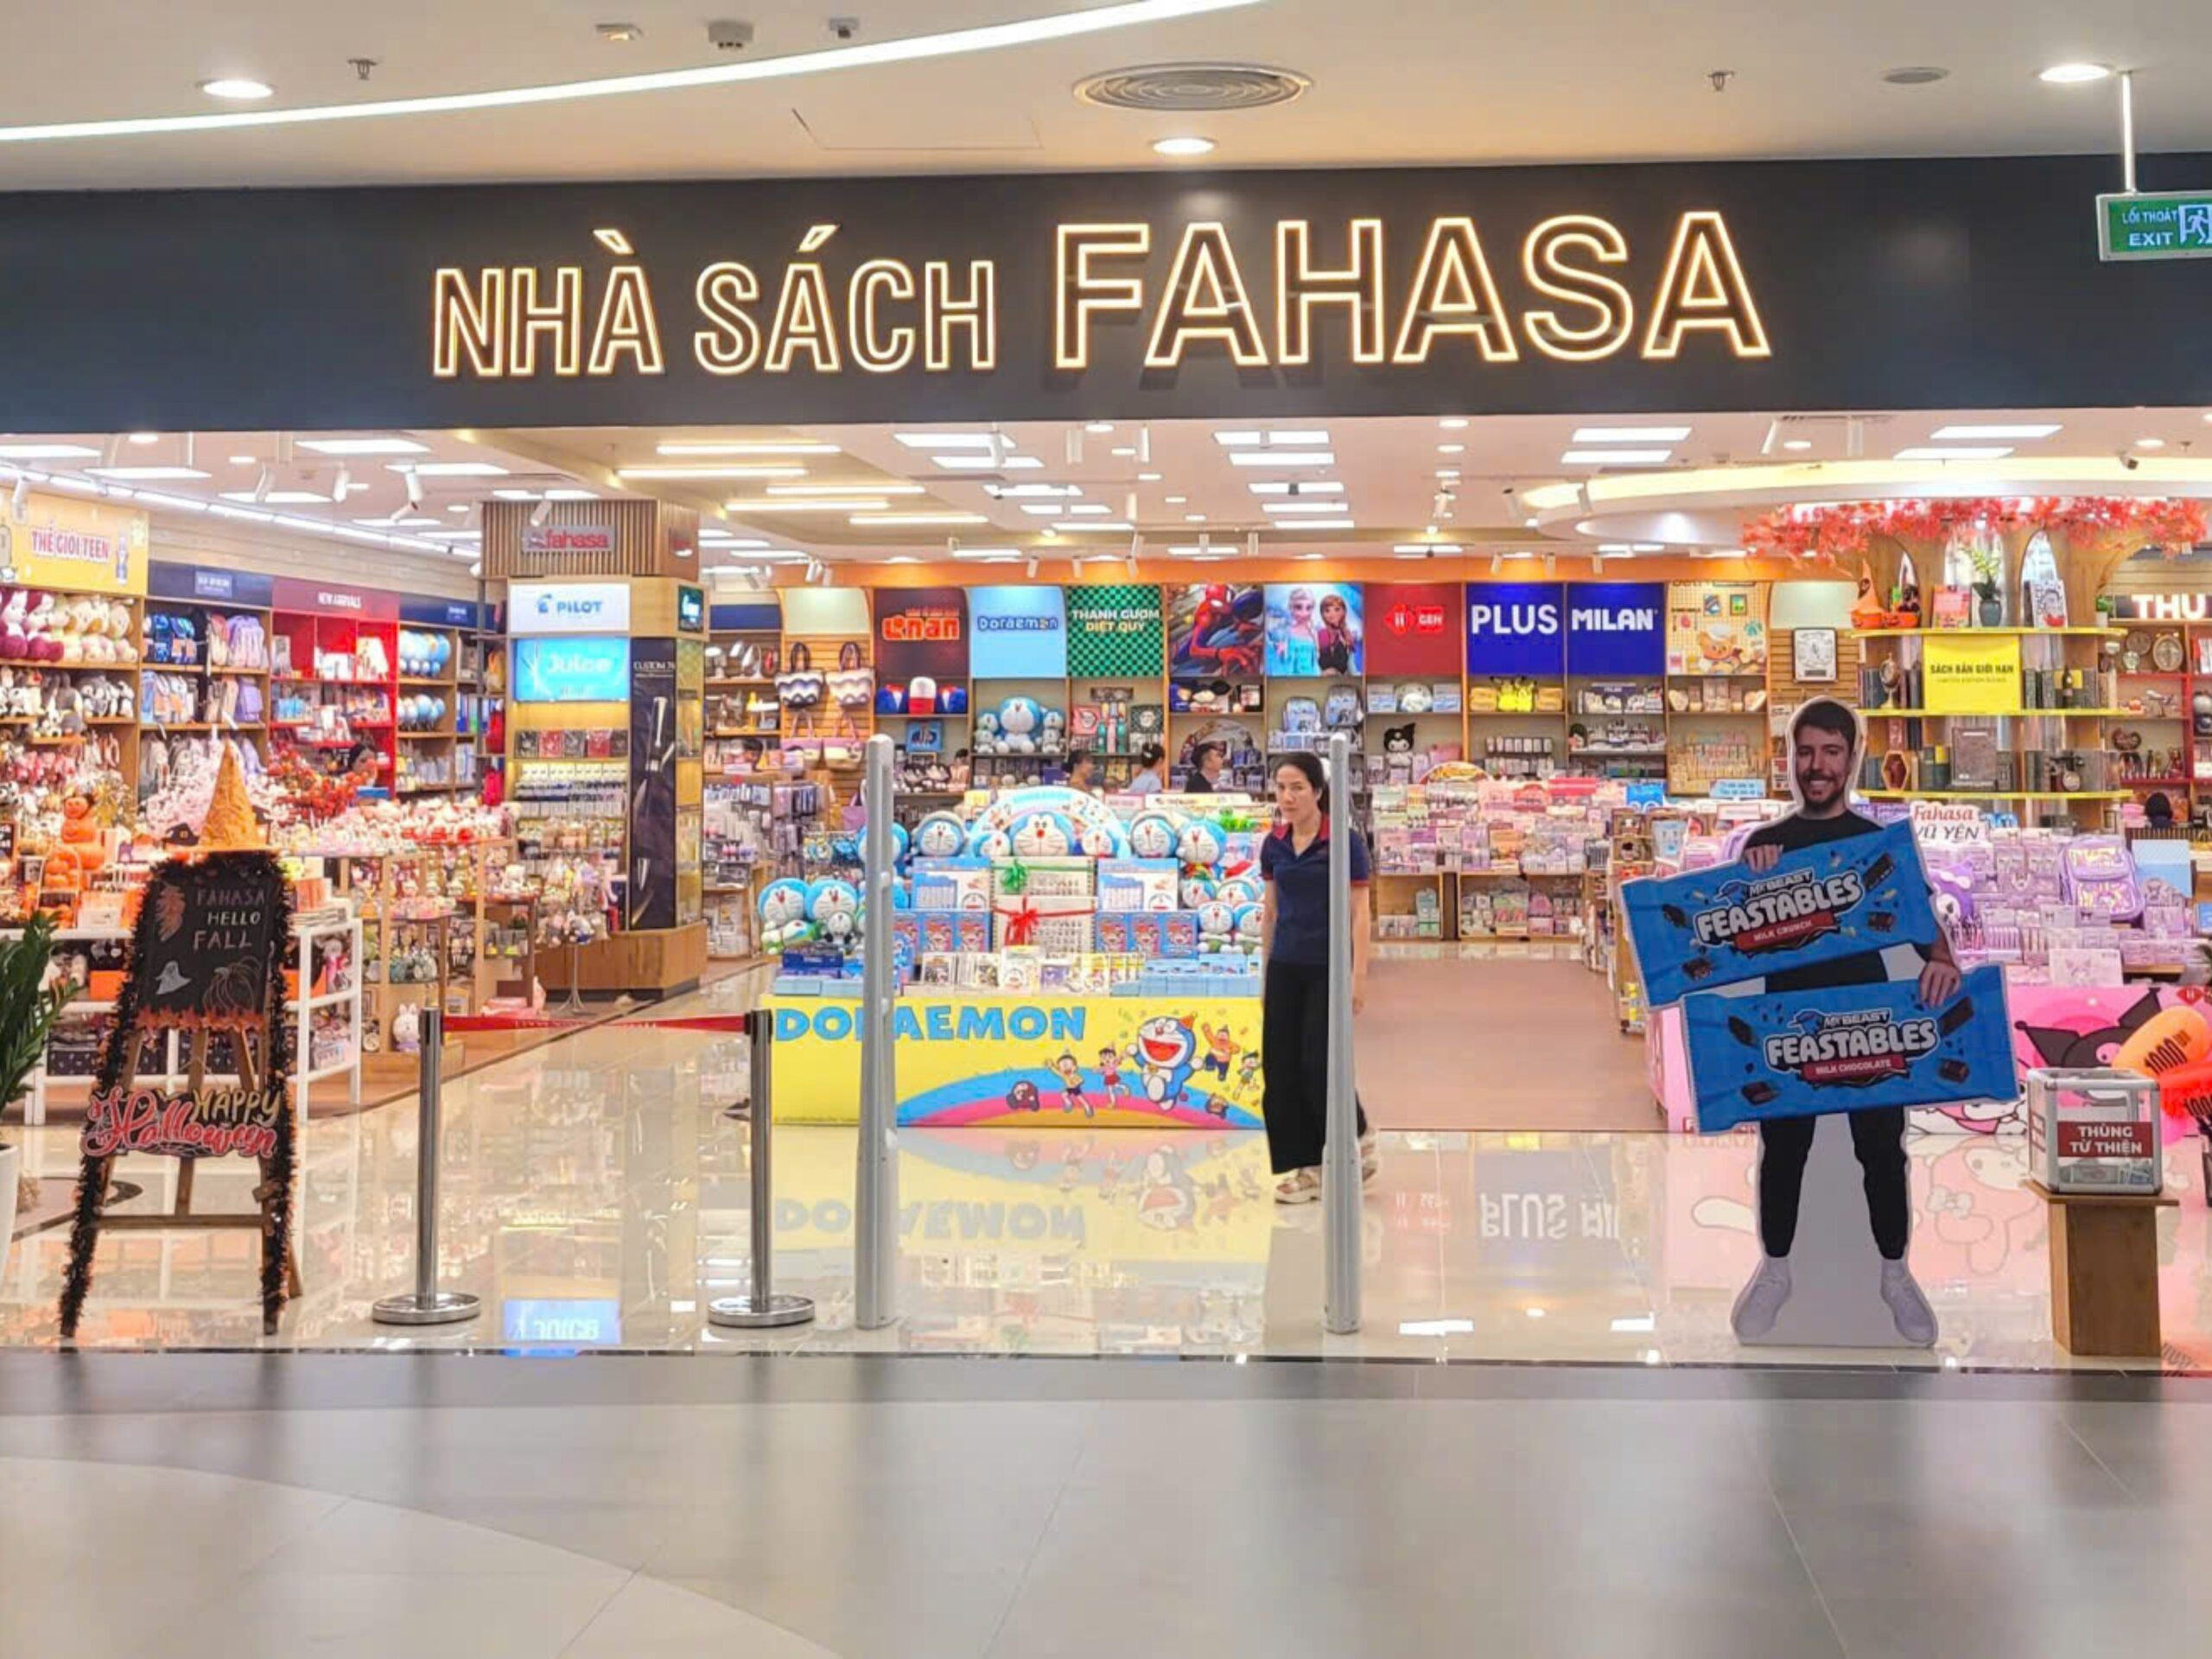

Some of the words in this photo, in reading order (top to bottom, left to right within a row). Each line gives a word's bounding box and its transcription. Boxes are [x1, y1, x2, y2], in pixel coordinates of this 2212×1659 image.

[2142, 207, 2177, 223] THOÁT
[2129, 232, 2173, 246] EXIT
[433, 228, 664, 377] NHÀ
[694, 224, 996, 376] SÁCH
[1055, 210, 1772, 369] FAHASA
[82, 536, 109, 559] TEEN
[545, 531, 608, 549] fahasa
[556, 601, 602, 613] PILOT
[1072, 608, 1117, 620] THANH
[977, 615, 1058, 632] Doraemon
[1471, 604, 1559, 635] PLUS
[1571, 608, 1654, 632] MILAN
[1914, 804, 1974, 822] Fahasa
[1944, 823, 1980, 840] YÊN
[197, 888, 265, 906] FAHASA
[1696, 872, 1859, 942] FEASTABLES
[207, 911, 262, 926] HELLO
[194, 929, 253, 950] FALL
[1754, 930, 1776, 942] MILK
[1777, 920, 1813, 937] CRUNCH
[775, 1005, 1086, 1042] DOAEMON
[1767, 1020, 1936, 1065] FEASTABLES
[1815, 1065, 1838, 1075] MILK
[1839, 1058, 1892, 1073] CHOCOLATE
[188, 1088, 281, 1127] HAPPY
[84, 1085, 277, 1157] Halloween
[2078, 1122, 2133, 1138] THÙNG
[2069, 1139, 2094, 1154] TỪ
[2096, 1141, 2143, 1157] THIỆN
